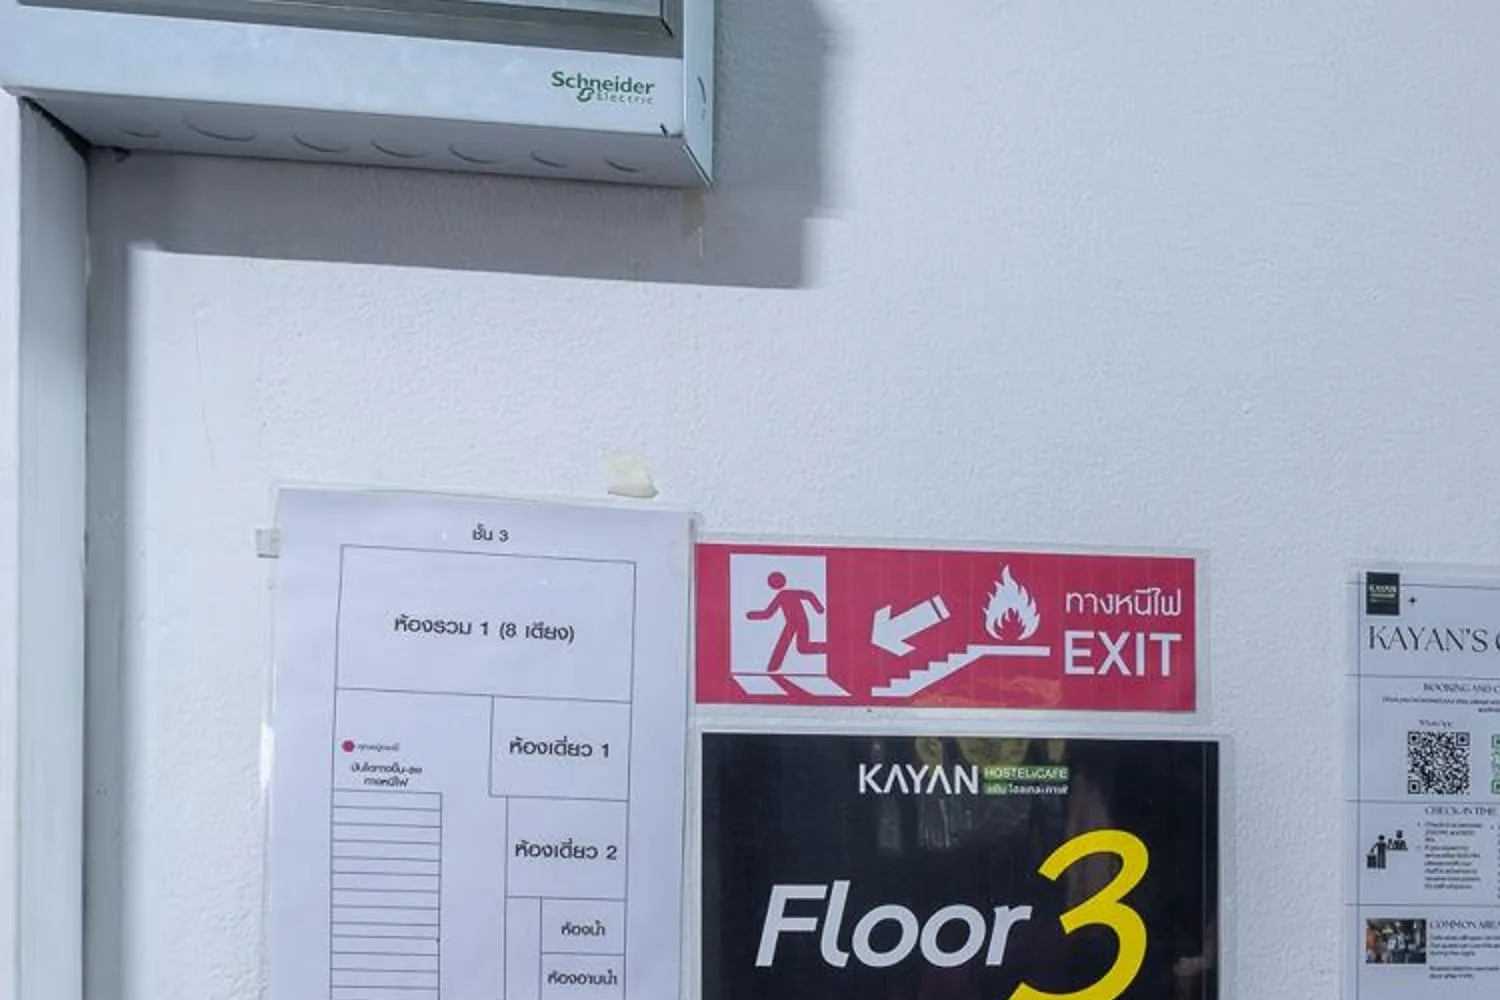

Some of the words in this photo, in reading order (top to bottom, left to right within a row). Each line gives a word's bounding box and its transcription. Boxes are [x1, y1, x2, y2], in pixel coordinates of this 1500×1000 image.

[551, 71, 655, 95] Schneider
[597, 91, 654, 105] Electric
[472, 523, 493, 543] ชั้น
[499, 528, 509, 543] 3
[1065, 587, 1182, 617] ทางหนีไฟ
[394, 612, 472, 636] ห้องรวม
[480, 621, 489, 636] 1
[499, 622, 517, 641] (8
[1368, 625, 1489, 652] KAYAN'S
[1064, 630, 1182, 677] EXIT
[509, 736, 593, 758] ห้องเดี่ยว
[601, 743, 610, 758] 1
[859, 763, 979, 795] KAYAN
[514, 838, 599, 860] ห้องเดี่ยว
[606, 845, 618, 860] 2
[561, 920, 606, 937] ห้องน้ำ
[754, 880, 1034, 968] Floor
[548, 969, 618, 986] ห้องอาบน้ำ
